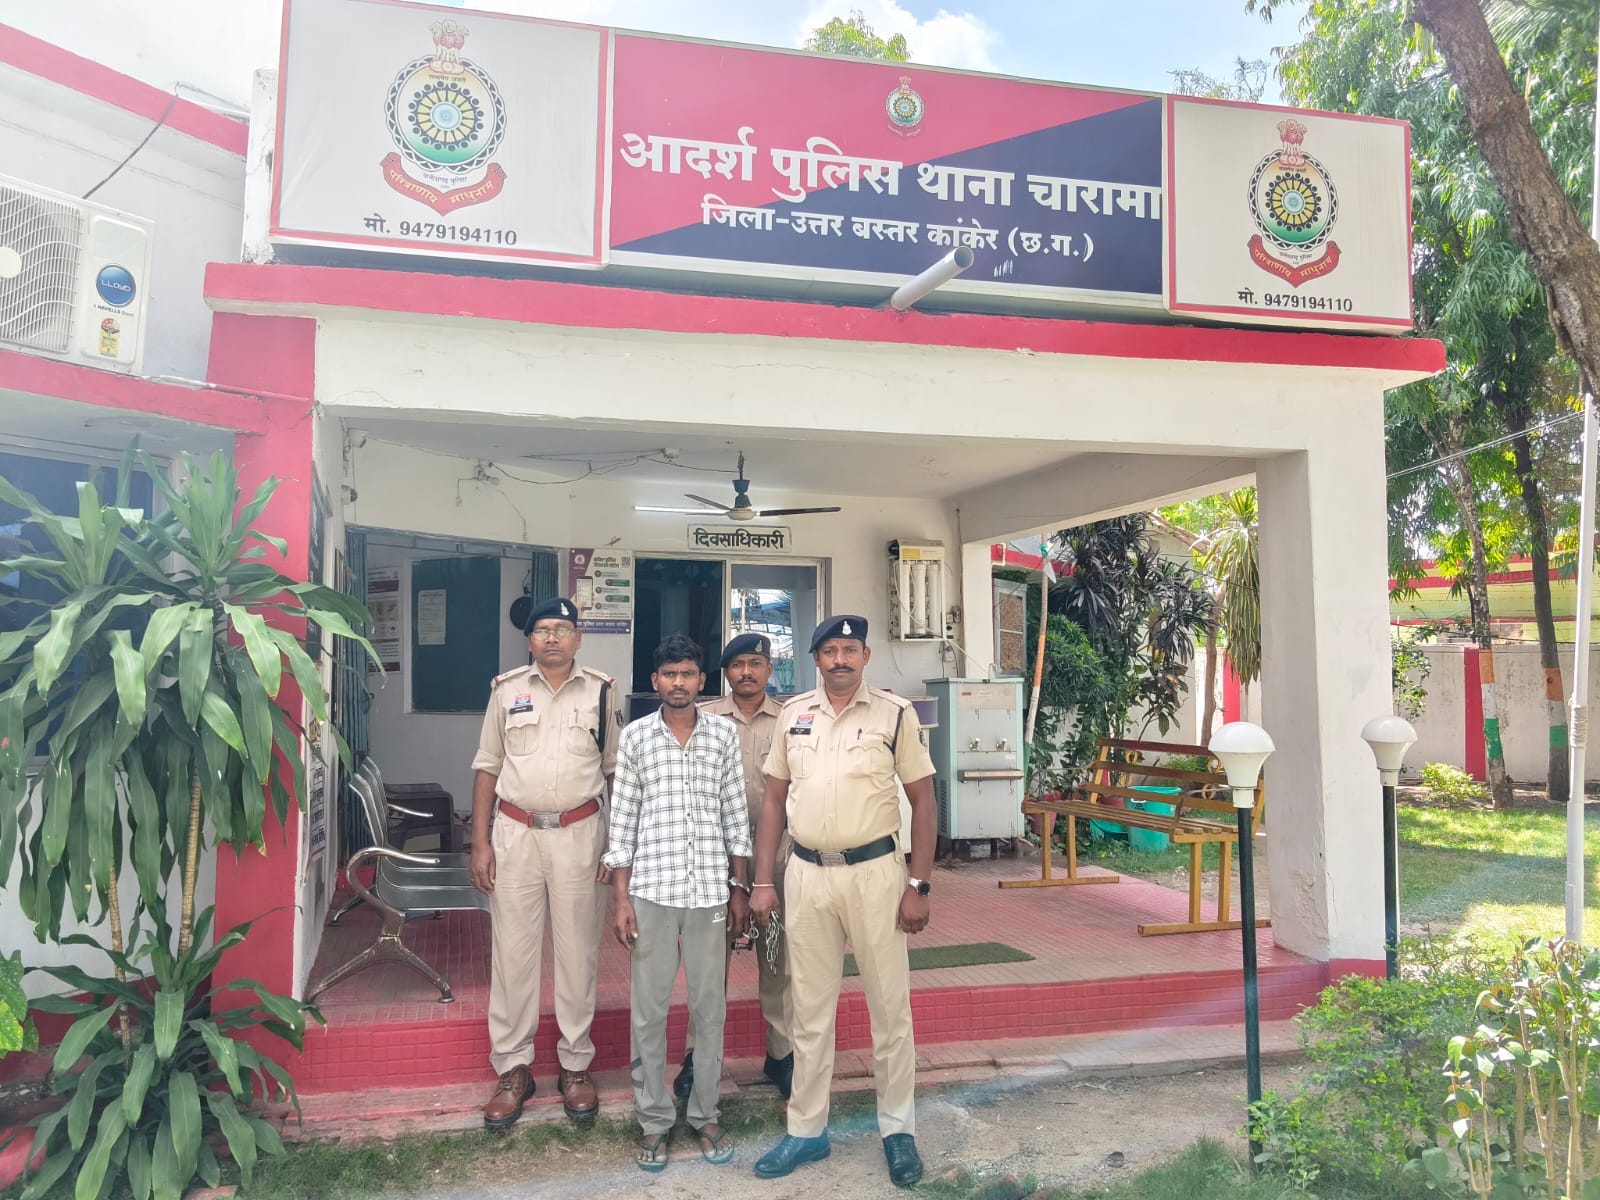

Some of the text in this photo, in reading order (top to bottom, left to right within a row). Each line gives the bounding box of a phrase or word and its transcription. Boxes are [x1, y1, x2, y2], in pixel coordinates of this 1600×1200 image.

[620, 126, 1162, 220] आदर्श पुलिस थाना चारामा
[399, 221, 517, 245] 9479194110
[700, 193, 1094, 262] जिला-उत्तर बस्तर कांकेर (छ.ग.)
[102, 280, 131, 291] LLOYD
[1264, 293, 1353, 312] 9479194110
[694, 528, 784, 549] दिवसाधिकारी
